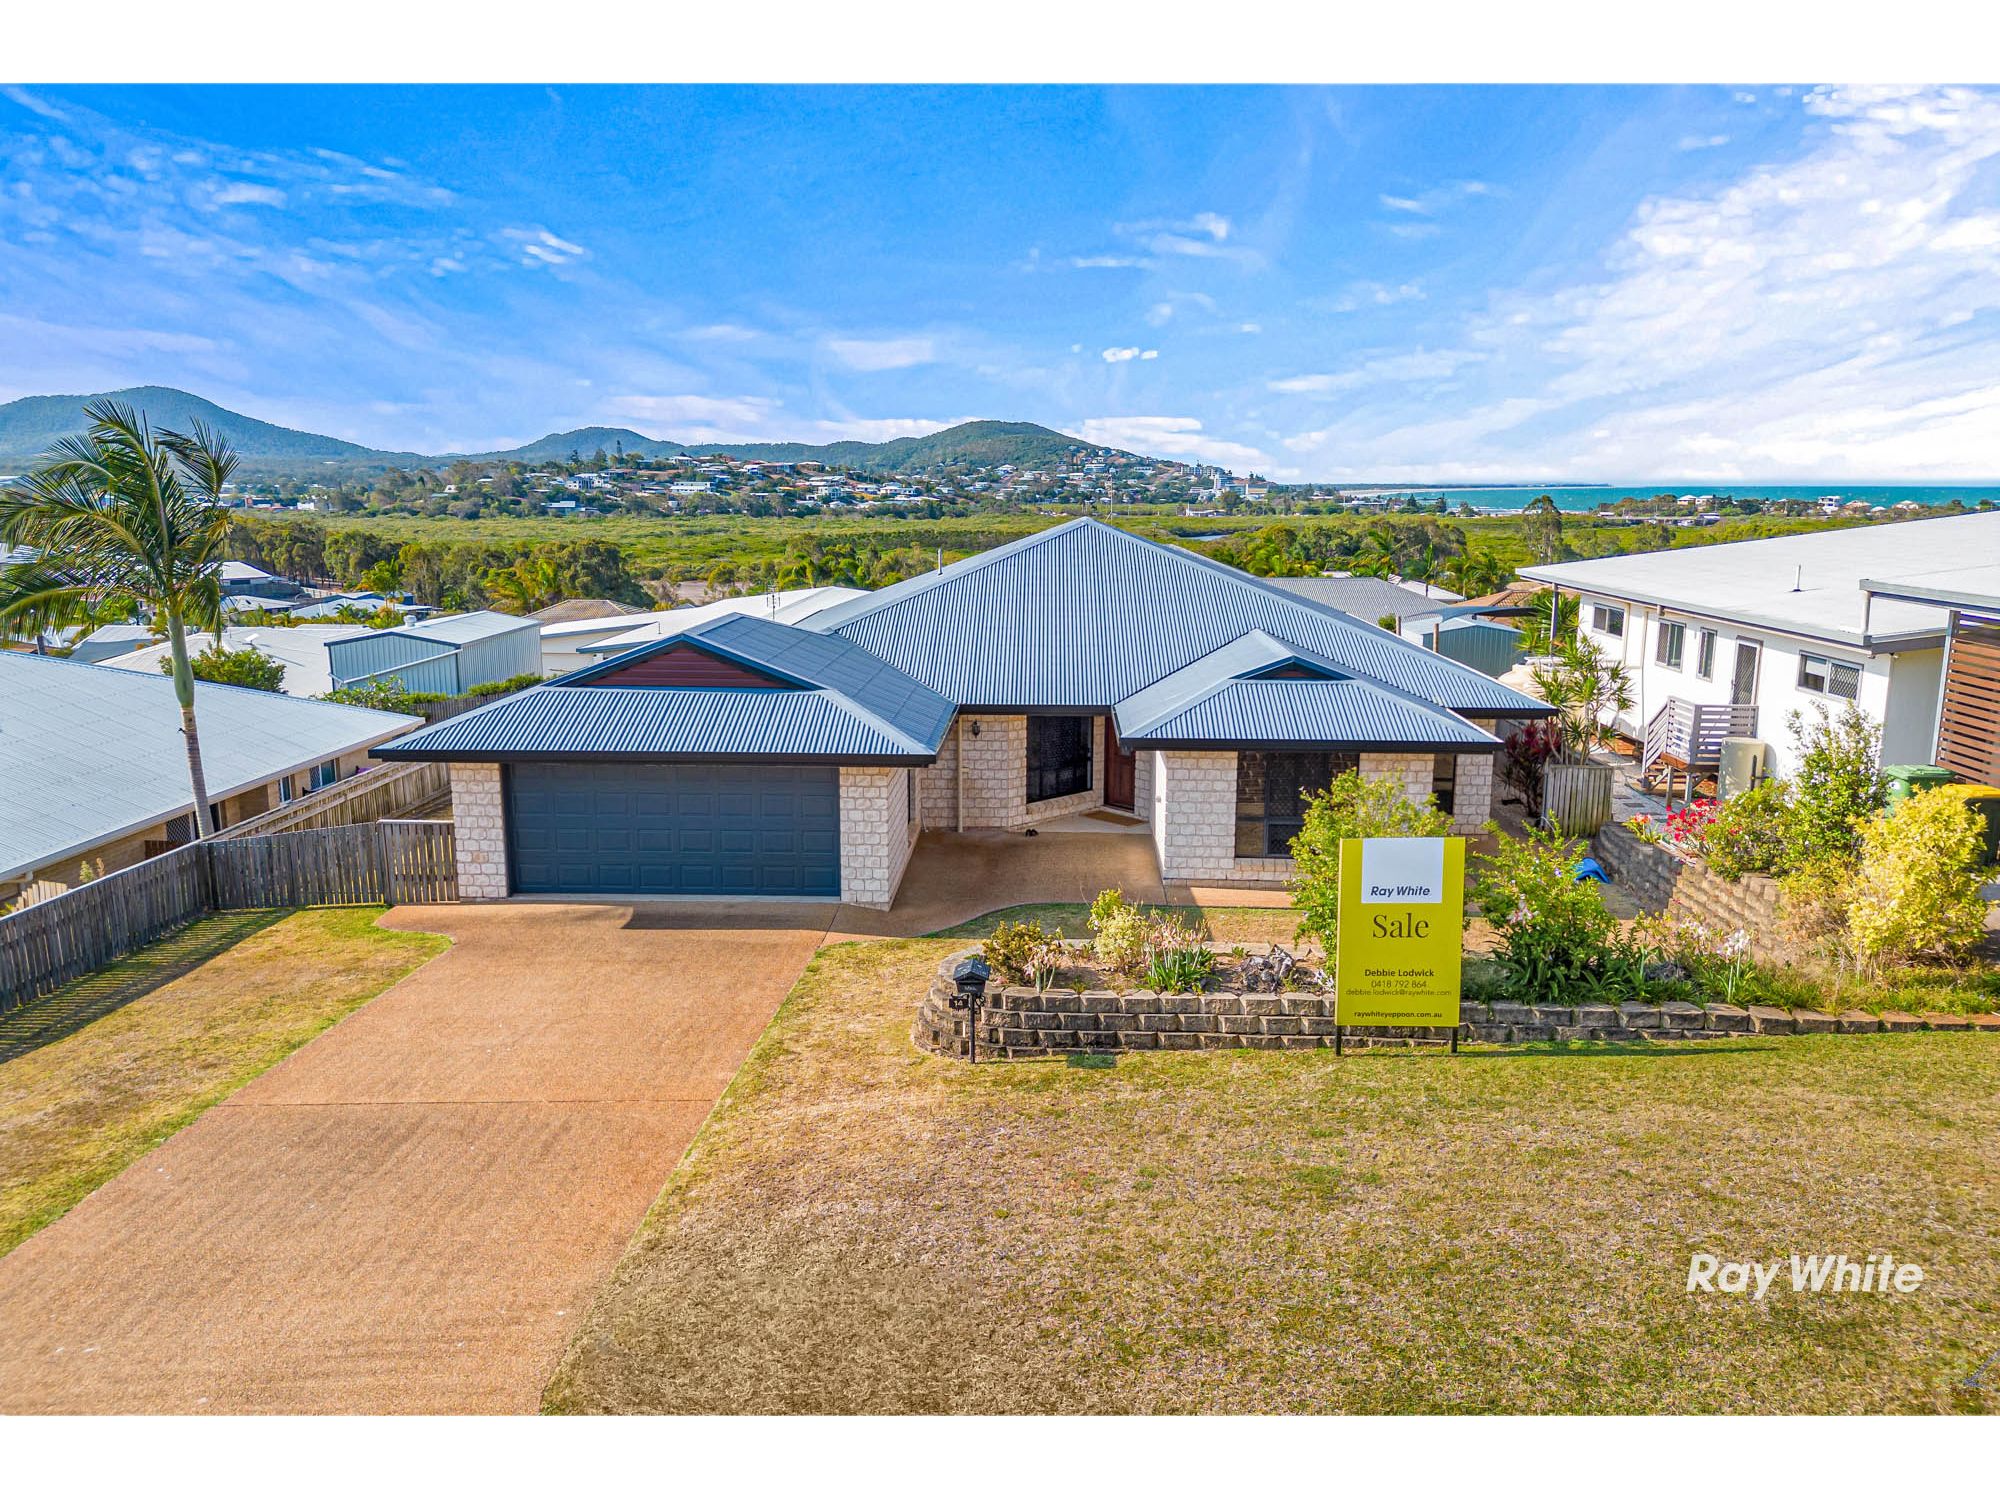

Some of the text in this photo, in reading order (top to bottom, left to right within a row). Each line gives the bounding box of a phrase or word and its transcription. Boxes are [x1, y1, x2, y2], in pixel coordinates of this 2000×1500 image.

[1370, 886, 1430, 898] Ray White
[1372, 912, 1429, 939] Sale
[1364, 969, 1434, 977] Debbie Lodwick
[1371, 980, 1427, 988] 0418 792 864
[1354, 1011, 1443, 1019] raywhiteyeppoon.com.au
